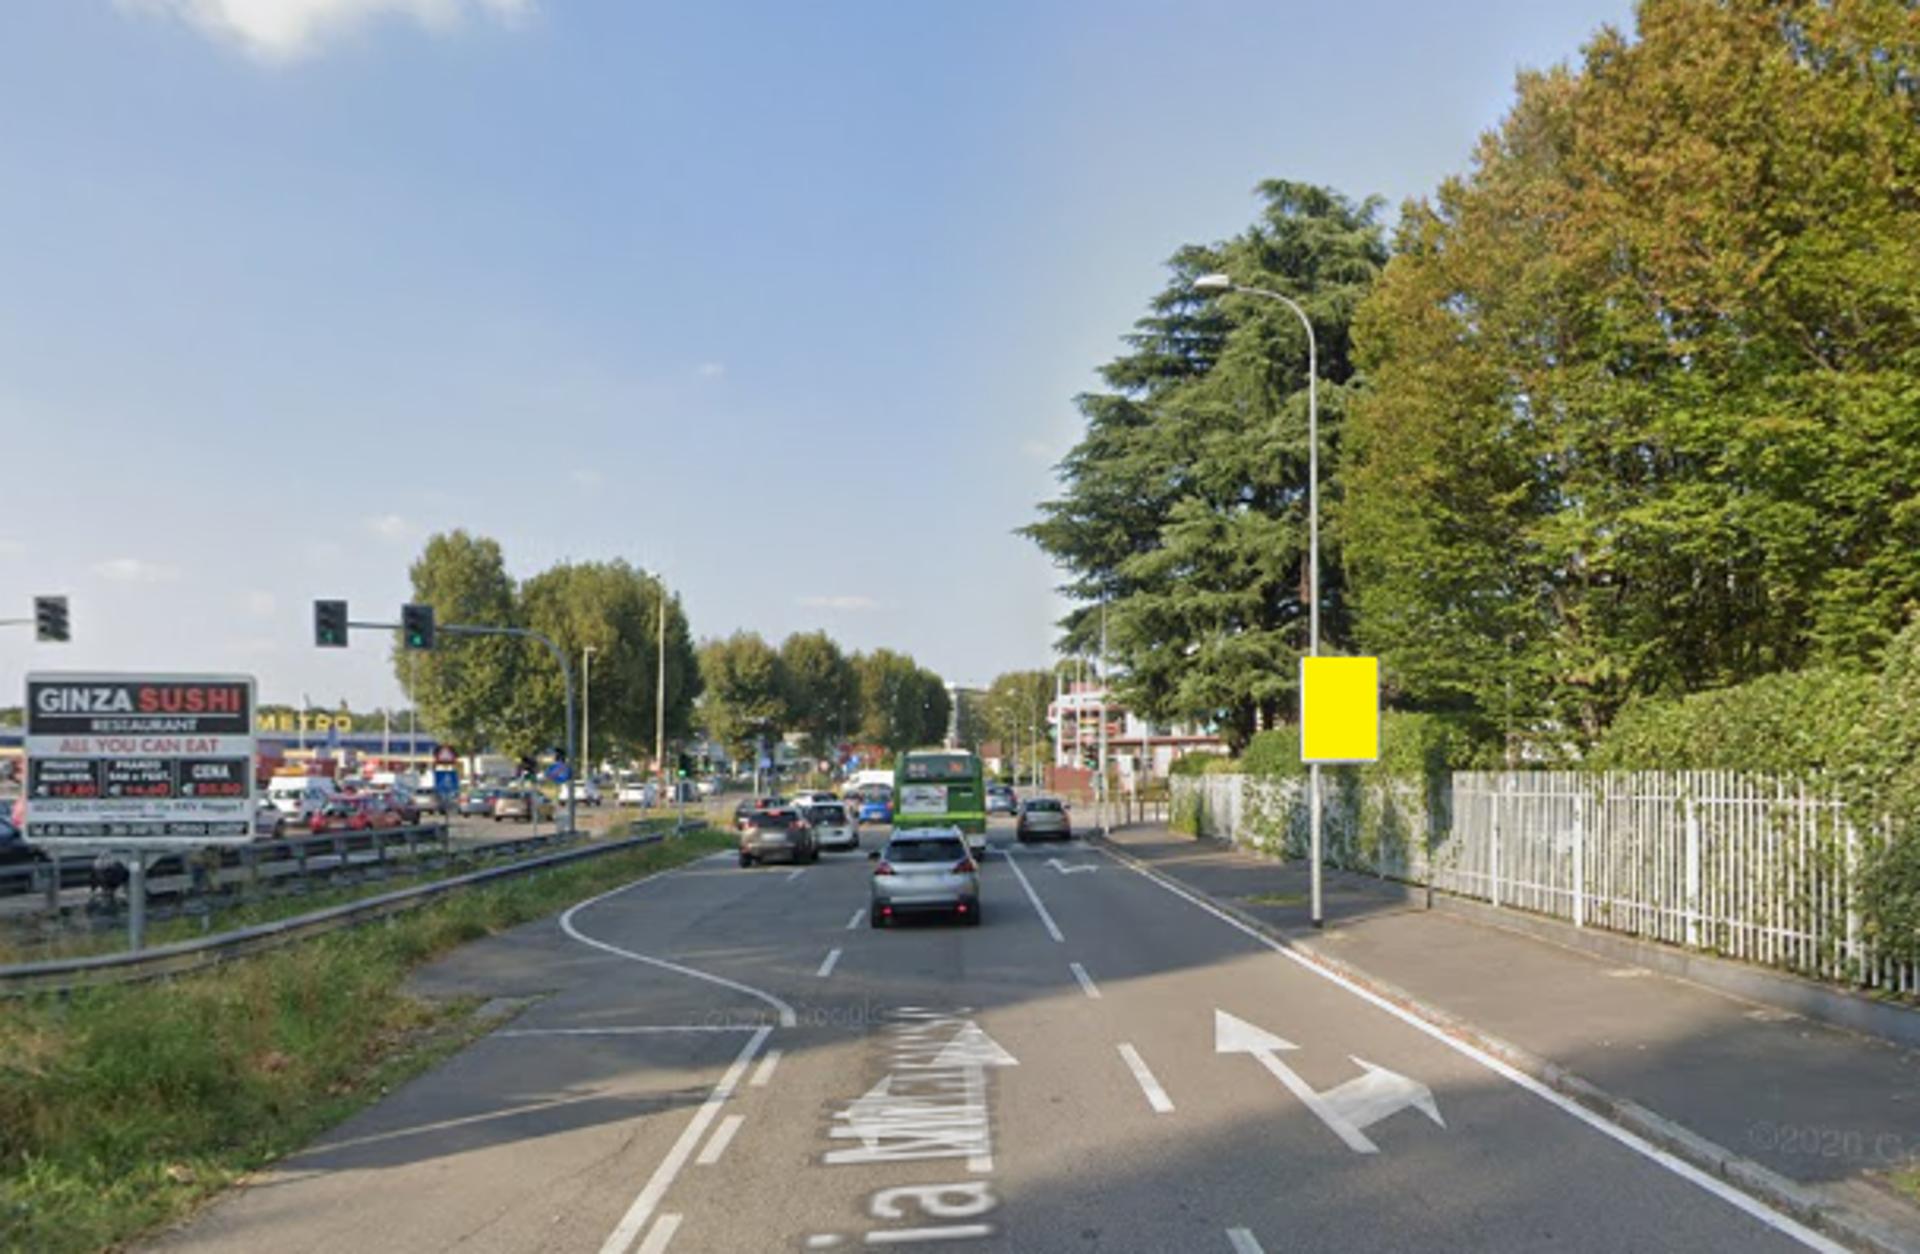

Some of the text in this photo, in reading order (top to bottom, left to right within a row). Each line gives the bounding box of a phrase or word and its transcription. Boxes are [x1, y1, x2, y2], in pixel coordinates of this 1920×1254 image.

[37, 687, 240, 712] GINZA SUSHI
[91, 718, 198, 731] RESTAURANT
[256, 712, 352, 733] METRO
[60, 738, 219, 753] ALL YOU CAN EAT
